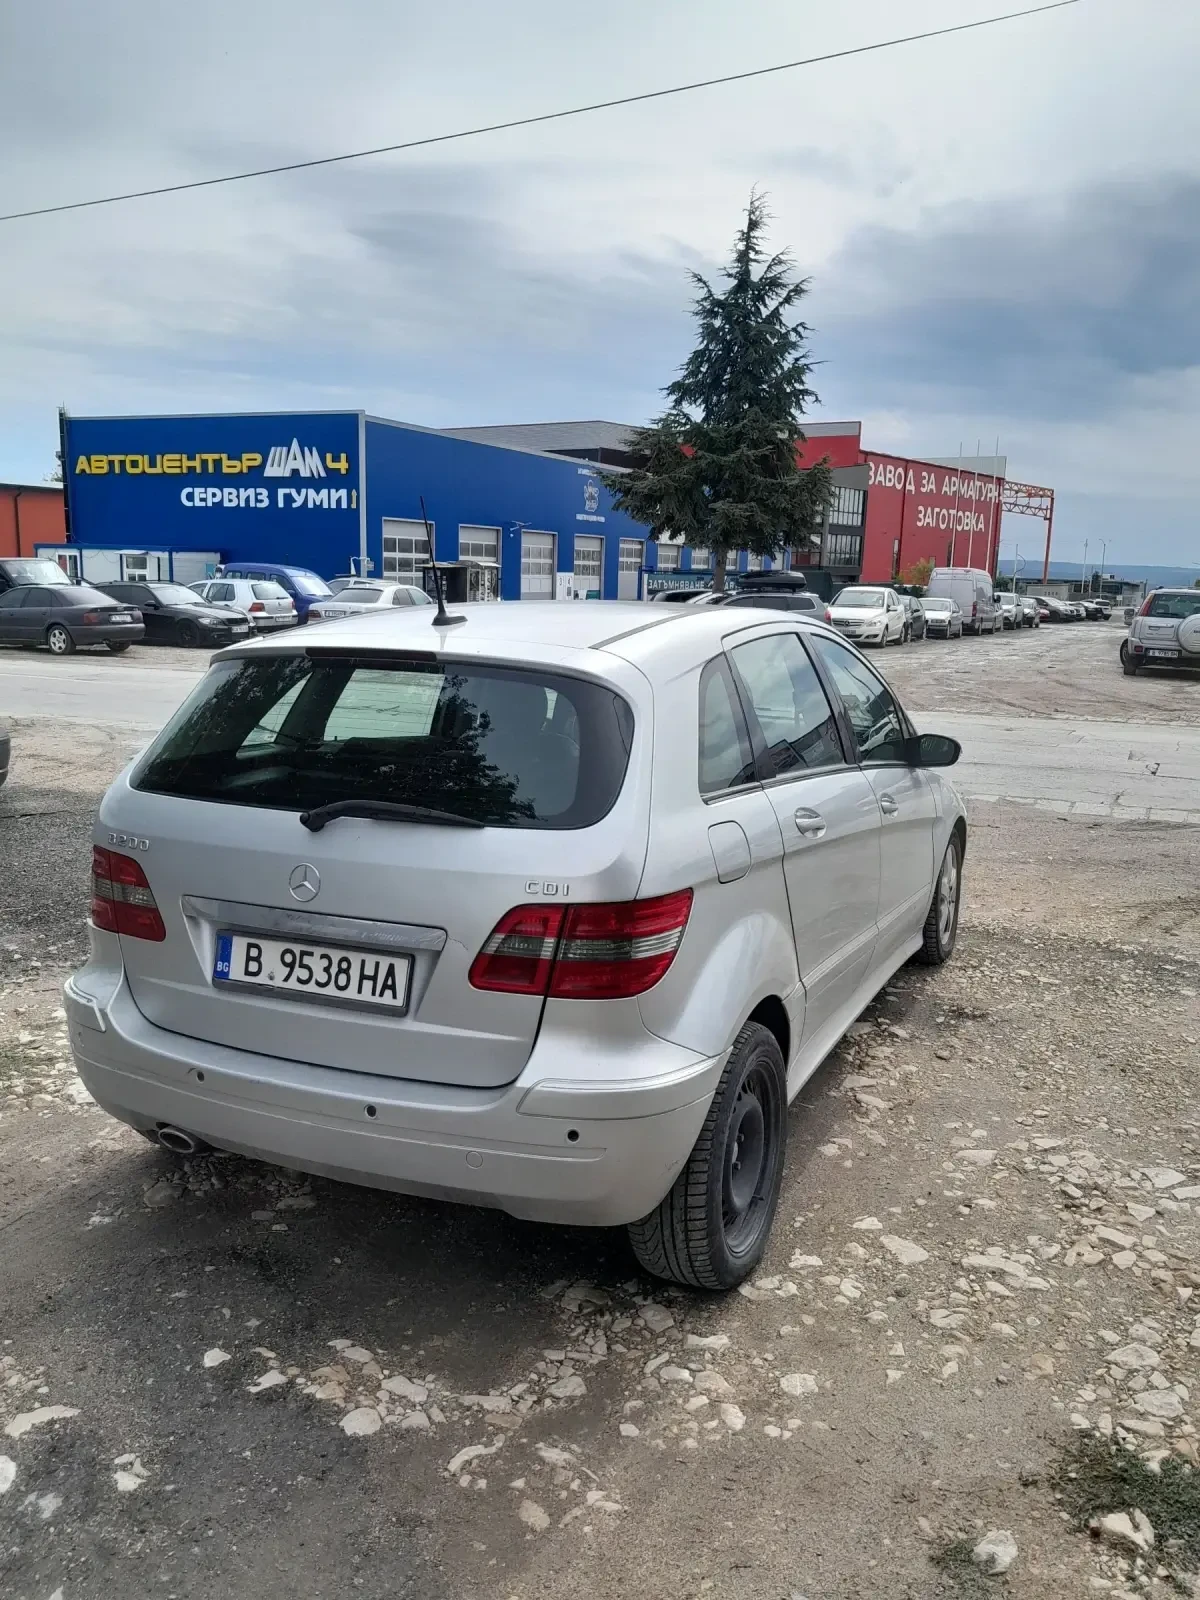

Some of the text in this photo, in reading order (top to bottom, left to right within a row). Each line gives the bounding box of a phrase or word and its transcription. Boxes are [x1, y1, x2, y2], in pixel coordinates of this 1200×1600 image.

[75, 437, 348, 479] АВТОЦЕНТЪР ШАМ 4
[868, 461, 916, 495] ЗАВОД
[920, 471, 936, 494] ЗА
[180, 487, 348, 509] СЕРВИЗ ГУМИ
[916, 505, 985, 532] ЗАГОТОВКА
[648, 579, 705, 590] ЗАТЪМНЯВАНЕ
[525, 880, 570, 897] CDI
[216, 961, 229, 972] BG
[244, 942, 398, 1000] B 9538 HA
